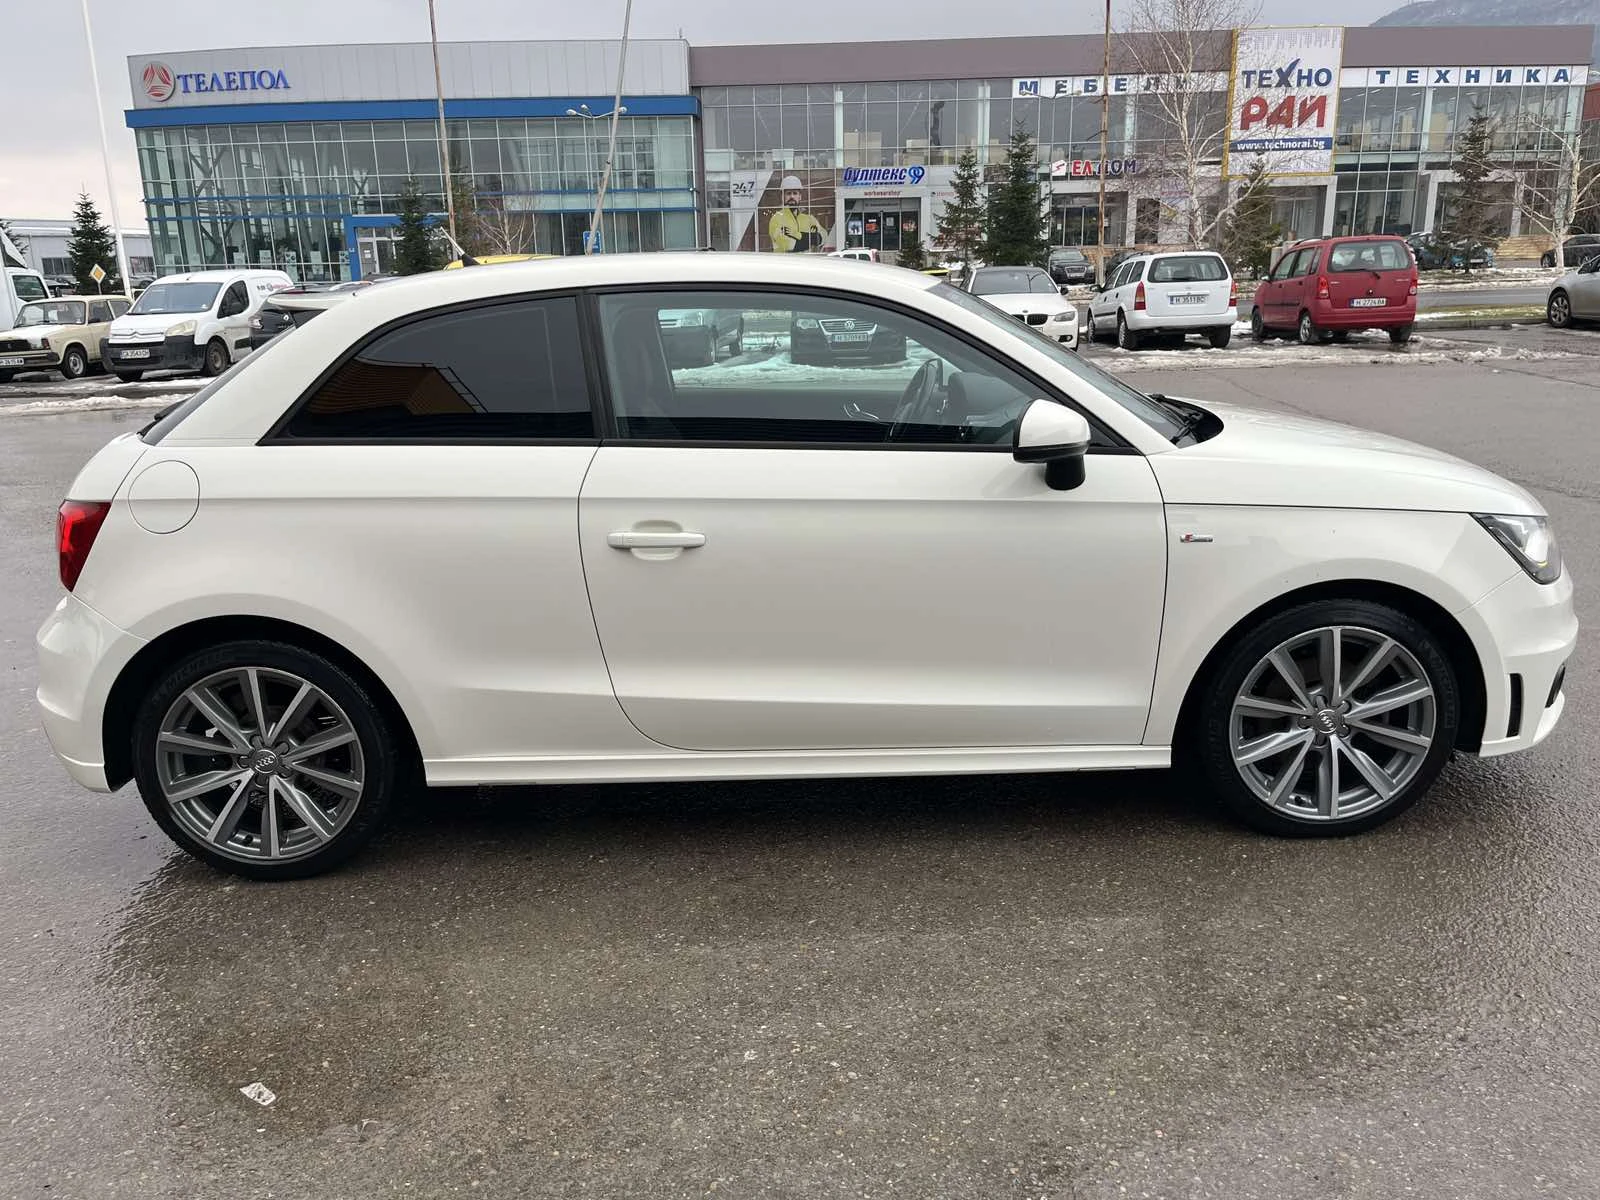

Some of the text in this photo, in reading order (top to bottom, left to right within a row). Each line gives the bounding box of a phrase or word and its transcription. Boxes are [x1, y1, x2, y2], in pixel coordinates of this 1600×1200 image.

[176, 69, 291, 94] ТЕЛЕПОЛ
[1241, 58, 1332, 88] ТЕХНО
[1375, 68, 1570, 84] ТЕХНИКА
[1240, 95, 1327, 130] РАЙ
[1236, 139, 1325, 150] www.technorai.bg
